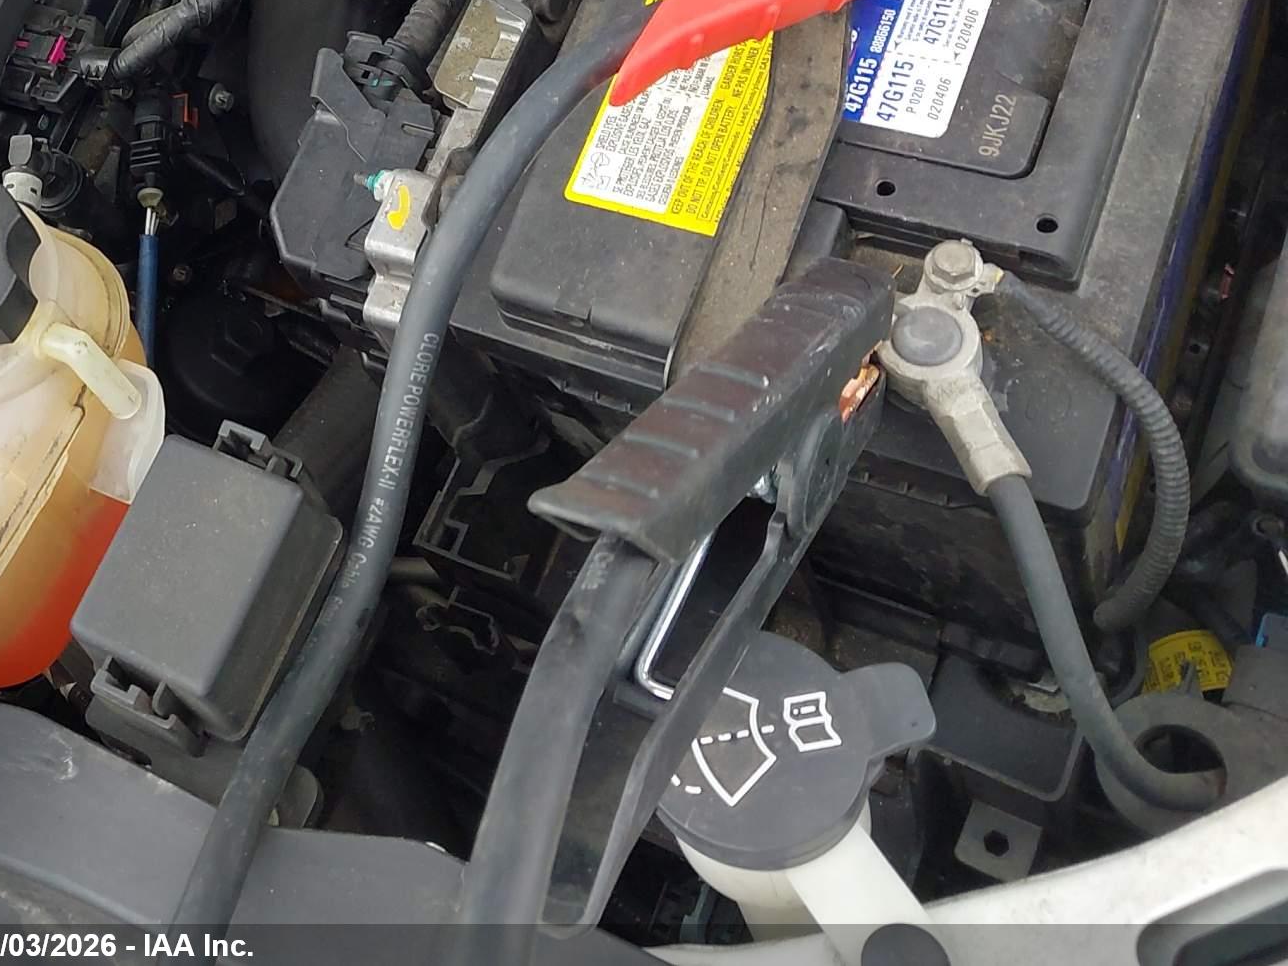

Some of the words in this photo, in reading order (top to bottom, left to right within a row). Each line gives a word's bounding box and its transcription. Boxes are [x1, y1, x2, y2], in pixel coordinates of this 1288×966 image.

[954, 7, 979, 51] 020406
[842, 54, 879, 115] 47G115
[869, 6, 897, 55] 88866150
[875, 57, 914, 124] 47G115
[906, 105, 917, 114] P
[926, 76, 952, 121] 020406
[978, 90, 1018, 159] 9JKJ22
[408, 329, 442, 385] CLORE
